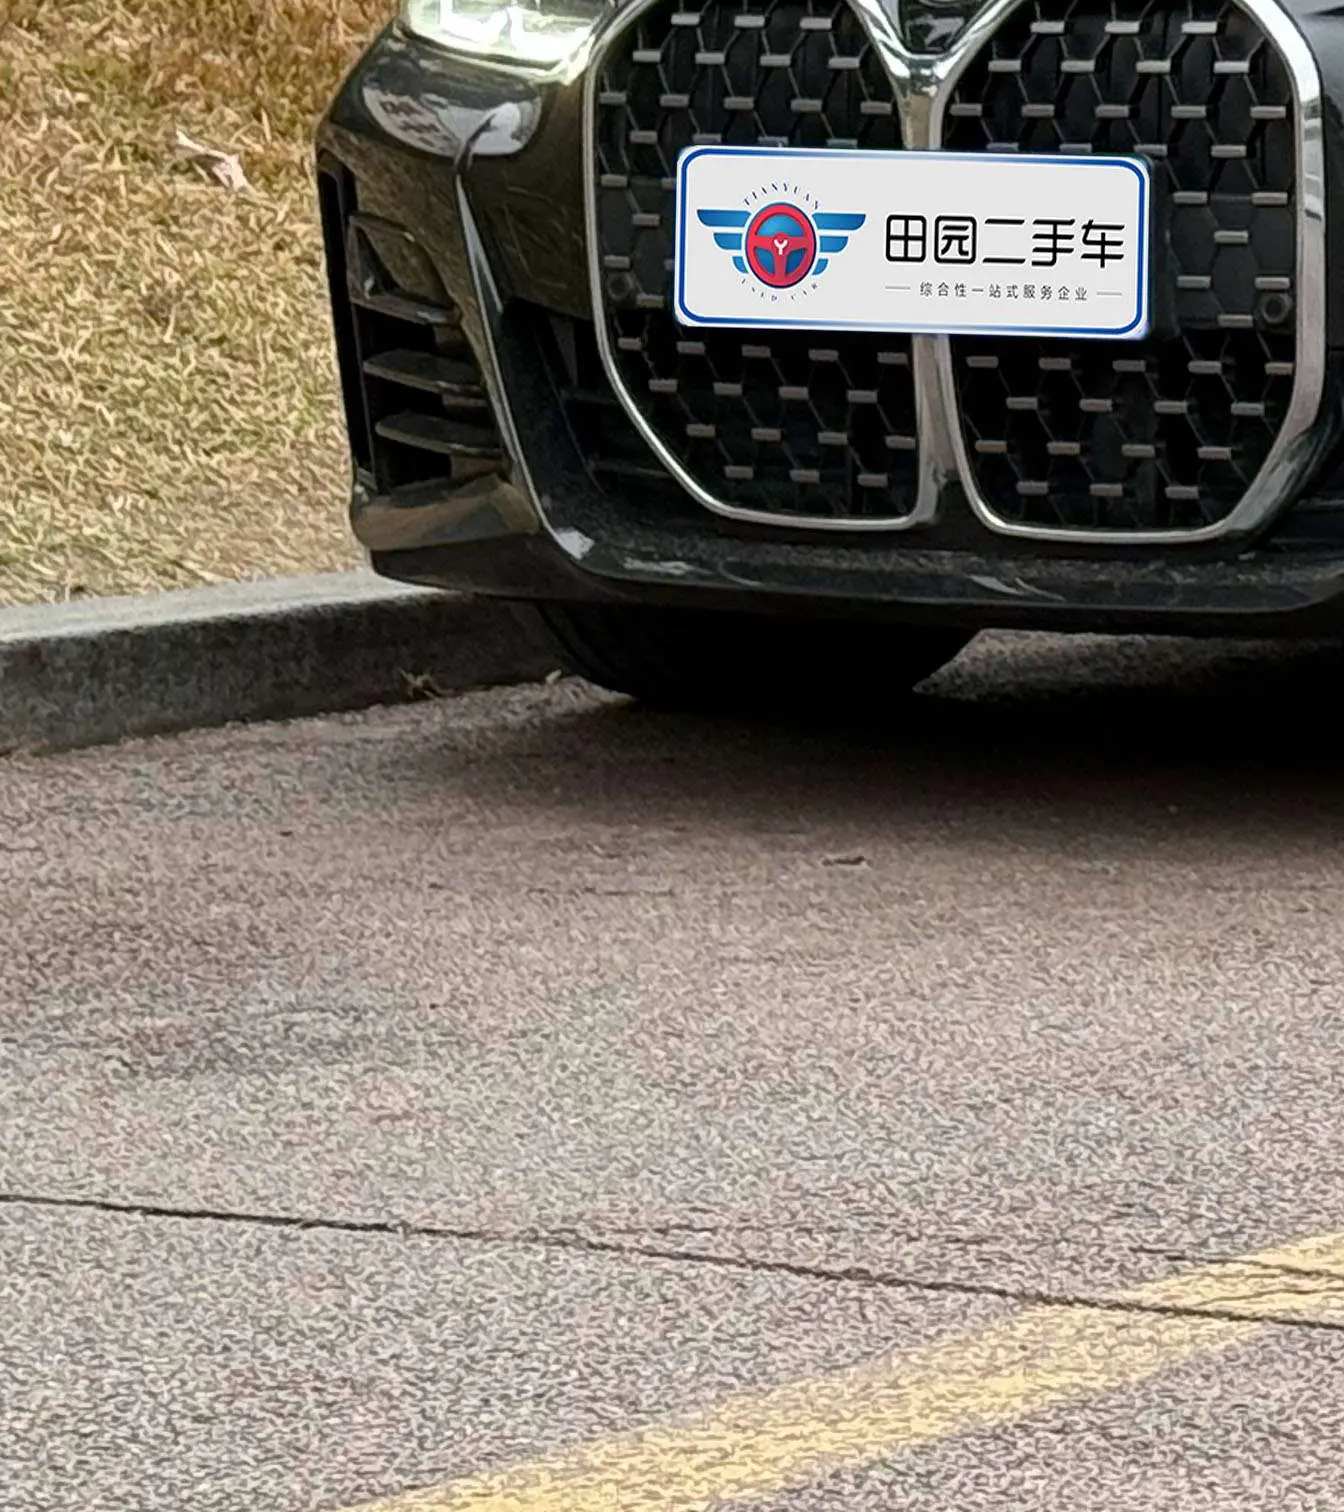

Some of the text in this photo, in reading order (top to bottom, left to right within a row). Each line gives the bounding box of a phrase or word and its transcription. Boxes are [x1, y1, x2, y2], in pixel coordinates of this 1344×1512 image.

[885, 214, 1126, 269] 田园二手车
[919, 281, 1088, 301] 综合性一站式服务企业
